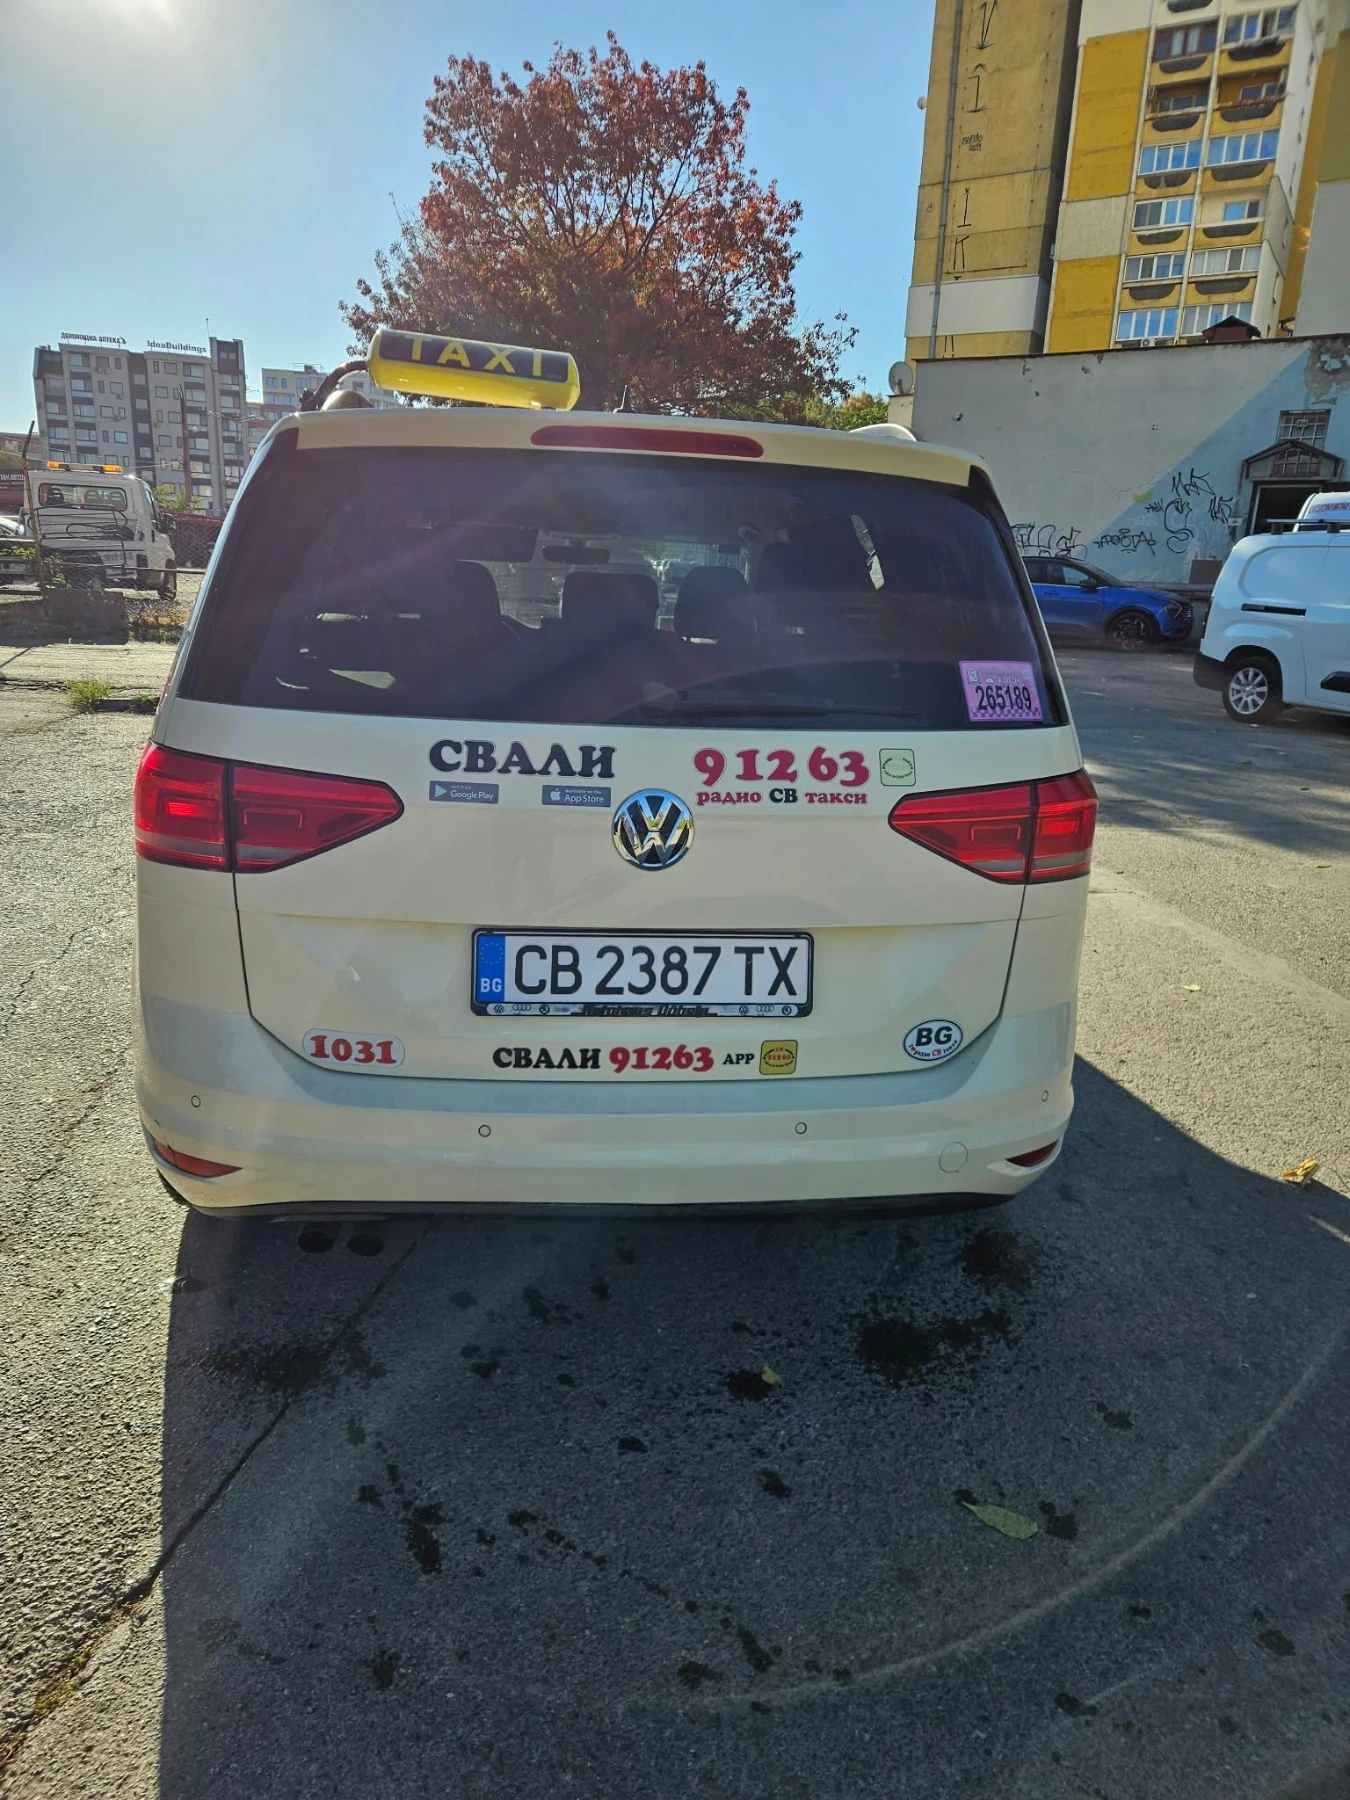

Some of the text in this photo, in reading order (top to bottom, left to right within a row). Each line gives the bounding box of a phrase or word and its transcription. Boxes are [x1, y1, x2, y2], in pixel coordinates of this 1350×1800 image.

[99, 335, 121, 344] АПТЕКА
[147, 340, 207, 353] IdeaBuildings
[404, 334, 544, 377] TAXI
[975, 685, 1032, 711] 265189
[429, 740, 616, 778] СВАЛИ
[694, 746, 871, 787] 91263
[450, 790, 494, 801] Google Play
[564, 794, 604, 804] App Store
[697, 788, 868, 805] радио СВ такси
[515, 945, 798, 996] CB 2387 TX
[480, 977, 503, 993] BG
[915, 1026, 953, 1047] BG
[310, 1035, 397, 1064] 1031
[492, 1047, 602, 1069] СВАЛИ
[609, 1044, 714, 1073] 91263
[722, 1052, 755, 1065] APP
